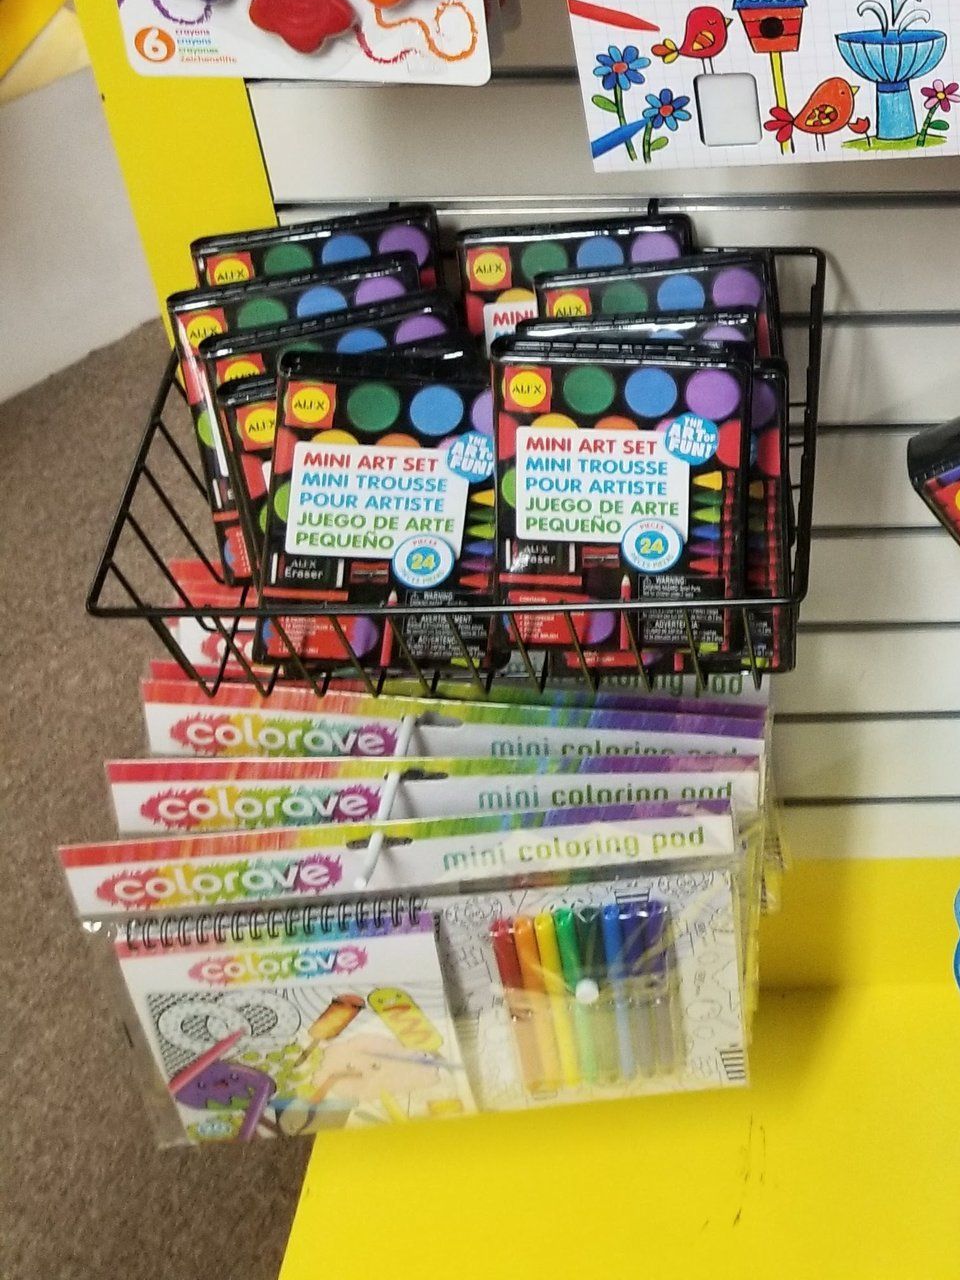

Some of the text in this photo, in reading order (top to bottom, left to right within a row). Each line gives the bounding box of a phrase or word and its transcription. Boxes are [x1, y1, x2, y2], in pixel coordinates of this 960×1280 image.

[526, 437, 658, 455] MINI ART SET
[526, 457, 668, 476] MINI TROUSSE
[525, 477, 667, 495] POUR ARTISTE
[526, 498, 679, 516] JUEGO DE ARTE
[526, 515, 622, 534] PEQUEÑO
[640, 538, 664, 553] 24
[186, 719, 384, 756] colorave
[442, 826, 704, 870] mini coloring pad
[114, 861, 329, 902] colorave
